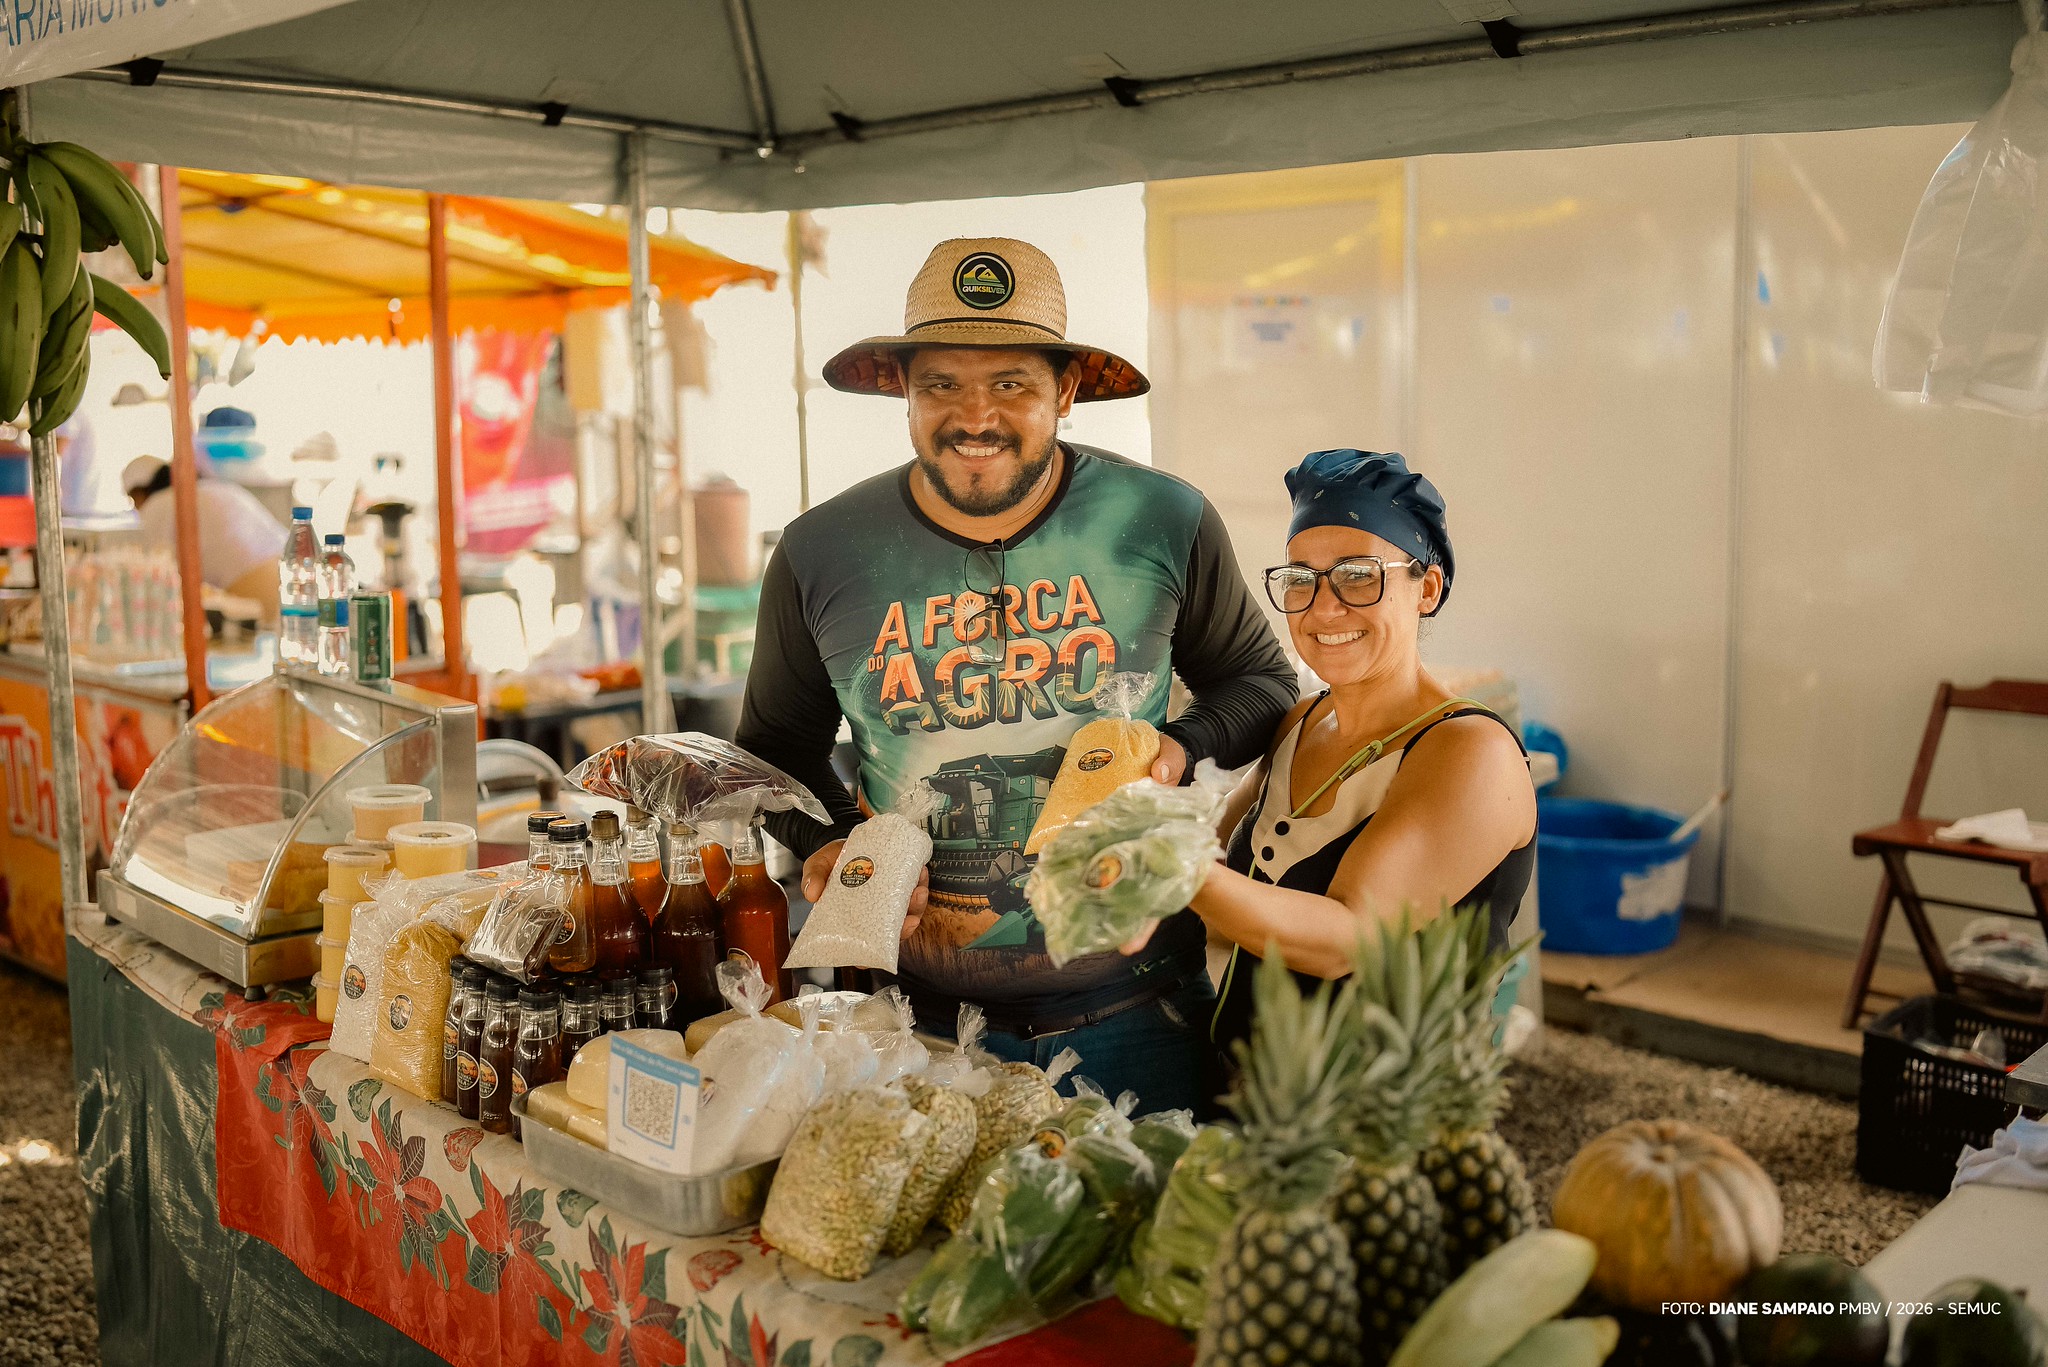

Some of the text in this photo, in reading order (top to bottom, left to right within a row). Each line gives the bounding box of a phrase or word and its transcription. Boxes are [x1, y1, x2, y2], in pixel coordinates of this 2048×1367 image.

[962, 286, 1005, 294] QUIKSILVER
[872, 600, 910, 655] A
[867, 626, 1117, 735] DO AGRO
